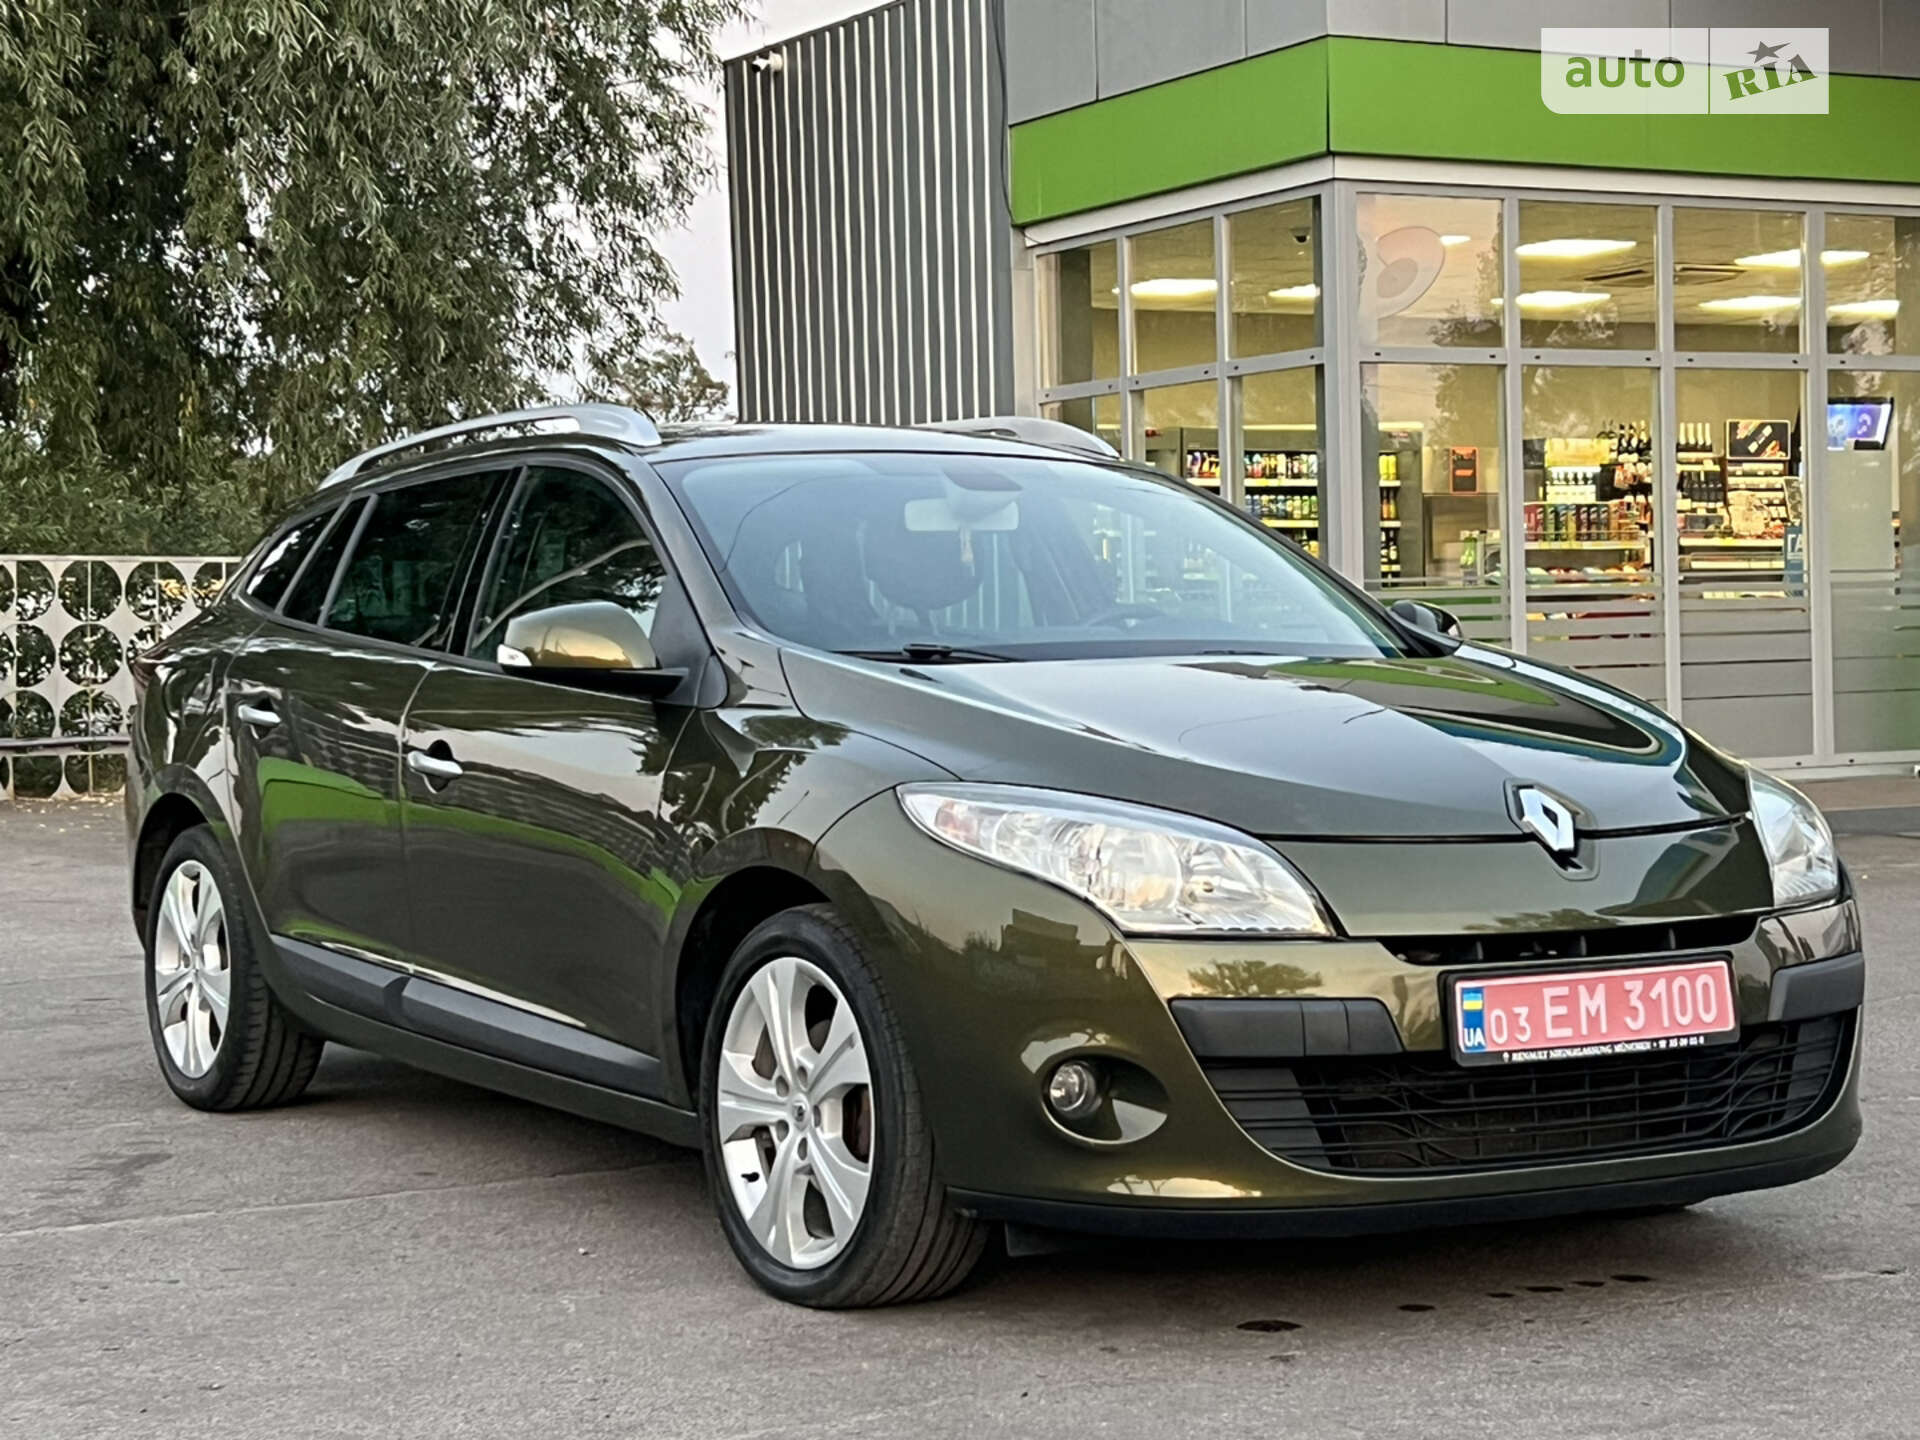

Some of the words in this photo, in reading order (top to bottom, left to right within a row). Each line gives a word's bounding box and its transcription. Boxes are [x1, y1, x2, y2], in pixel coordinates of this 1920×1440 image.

[1490, 1007, 1532, 1045] 03
[1542, 983, 1608, 1039] EM
[1623, 973, 1718, 1031] 3100
[1464, 1028, 1486, 1047] UA
